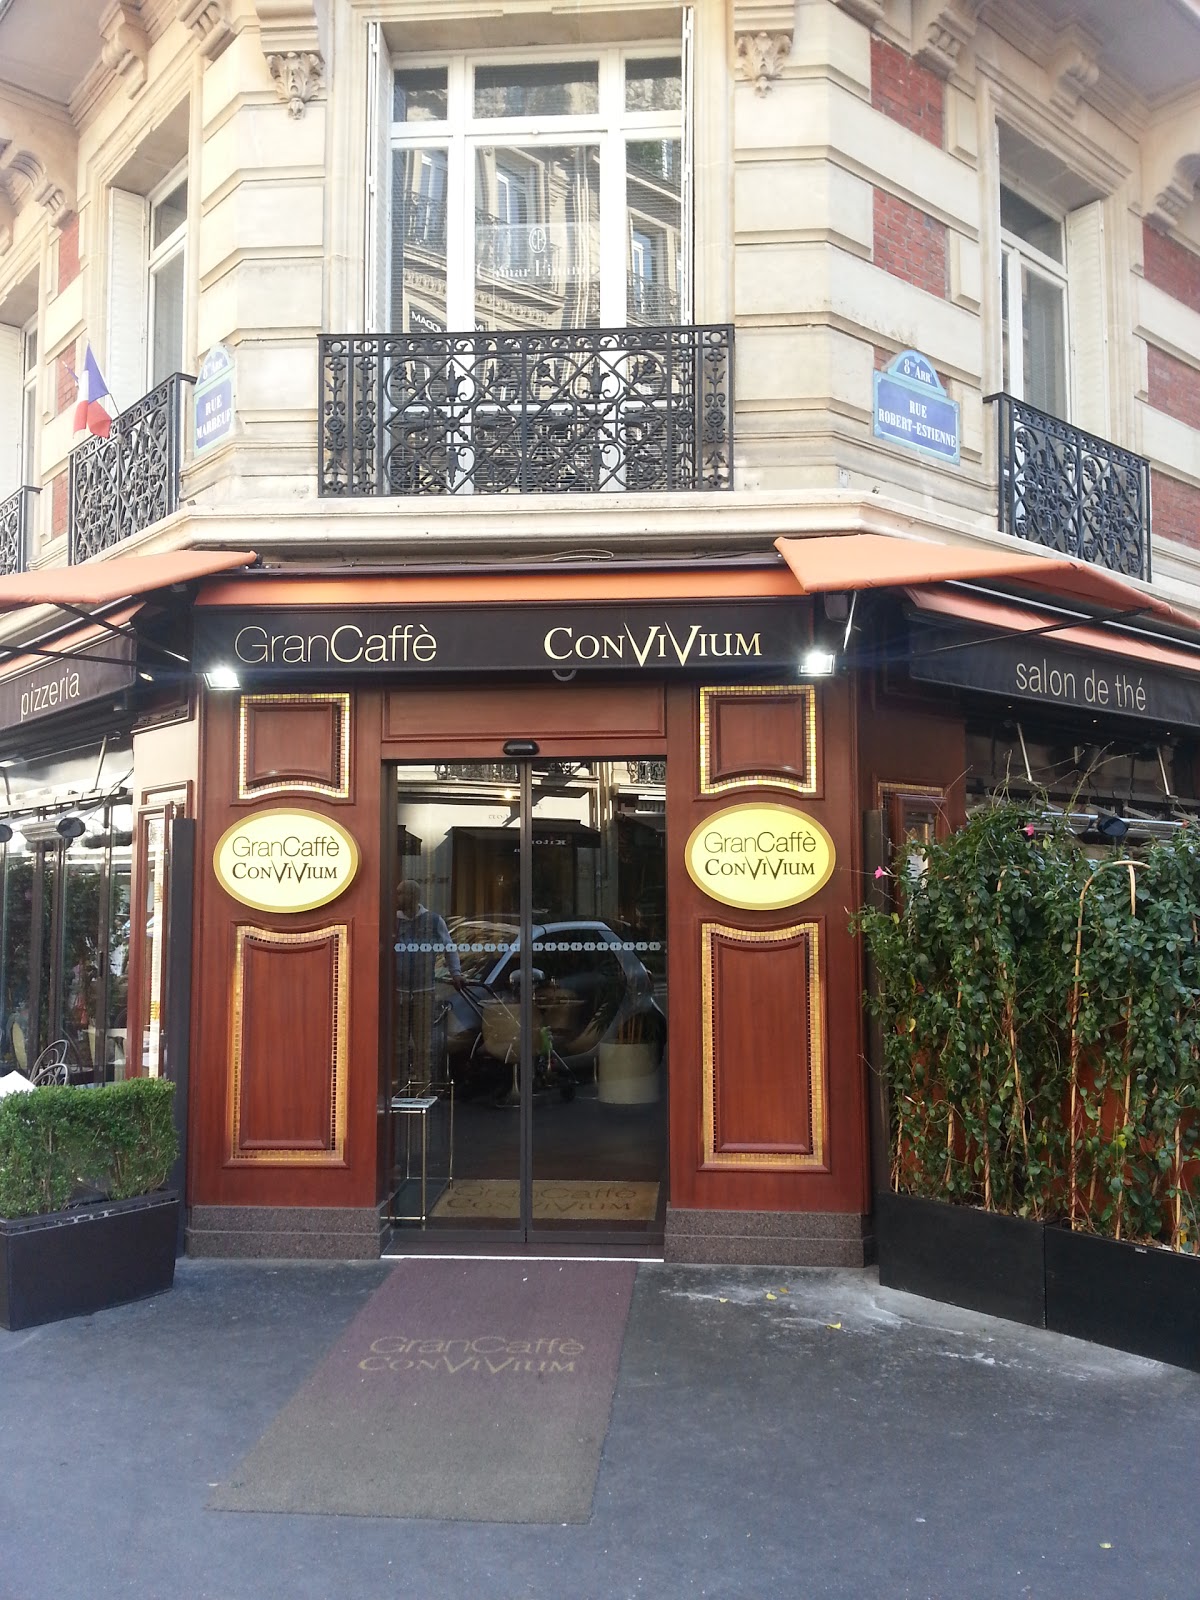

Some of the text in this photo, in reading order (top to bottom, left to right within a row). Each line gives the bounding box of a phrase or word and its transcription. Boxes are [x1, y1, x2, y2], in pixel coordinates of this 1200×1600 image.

[205, 393, 223, 416] RUE
[909, 399, 928, 419] RUE
[196, 407, 232, 439] MARBEUF
[878, 408, 957, 448] ROBERT-ESTIENNE
[235, 623, 438, 665] GranCaffè
[20, 668, 80, 722] pizzeria
[1015, 658, 1147, 711] salon de thé
[232, 835, 340, 858] GranCaffè
[704, 830, 817, 854] GranCaffè
